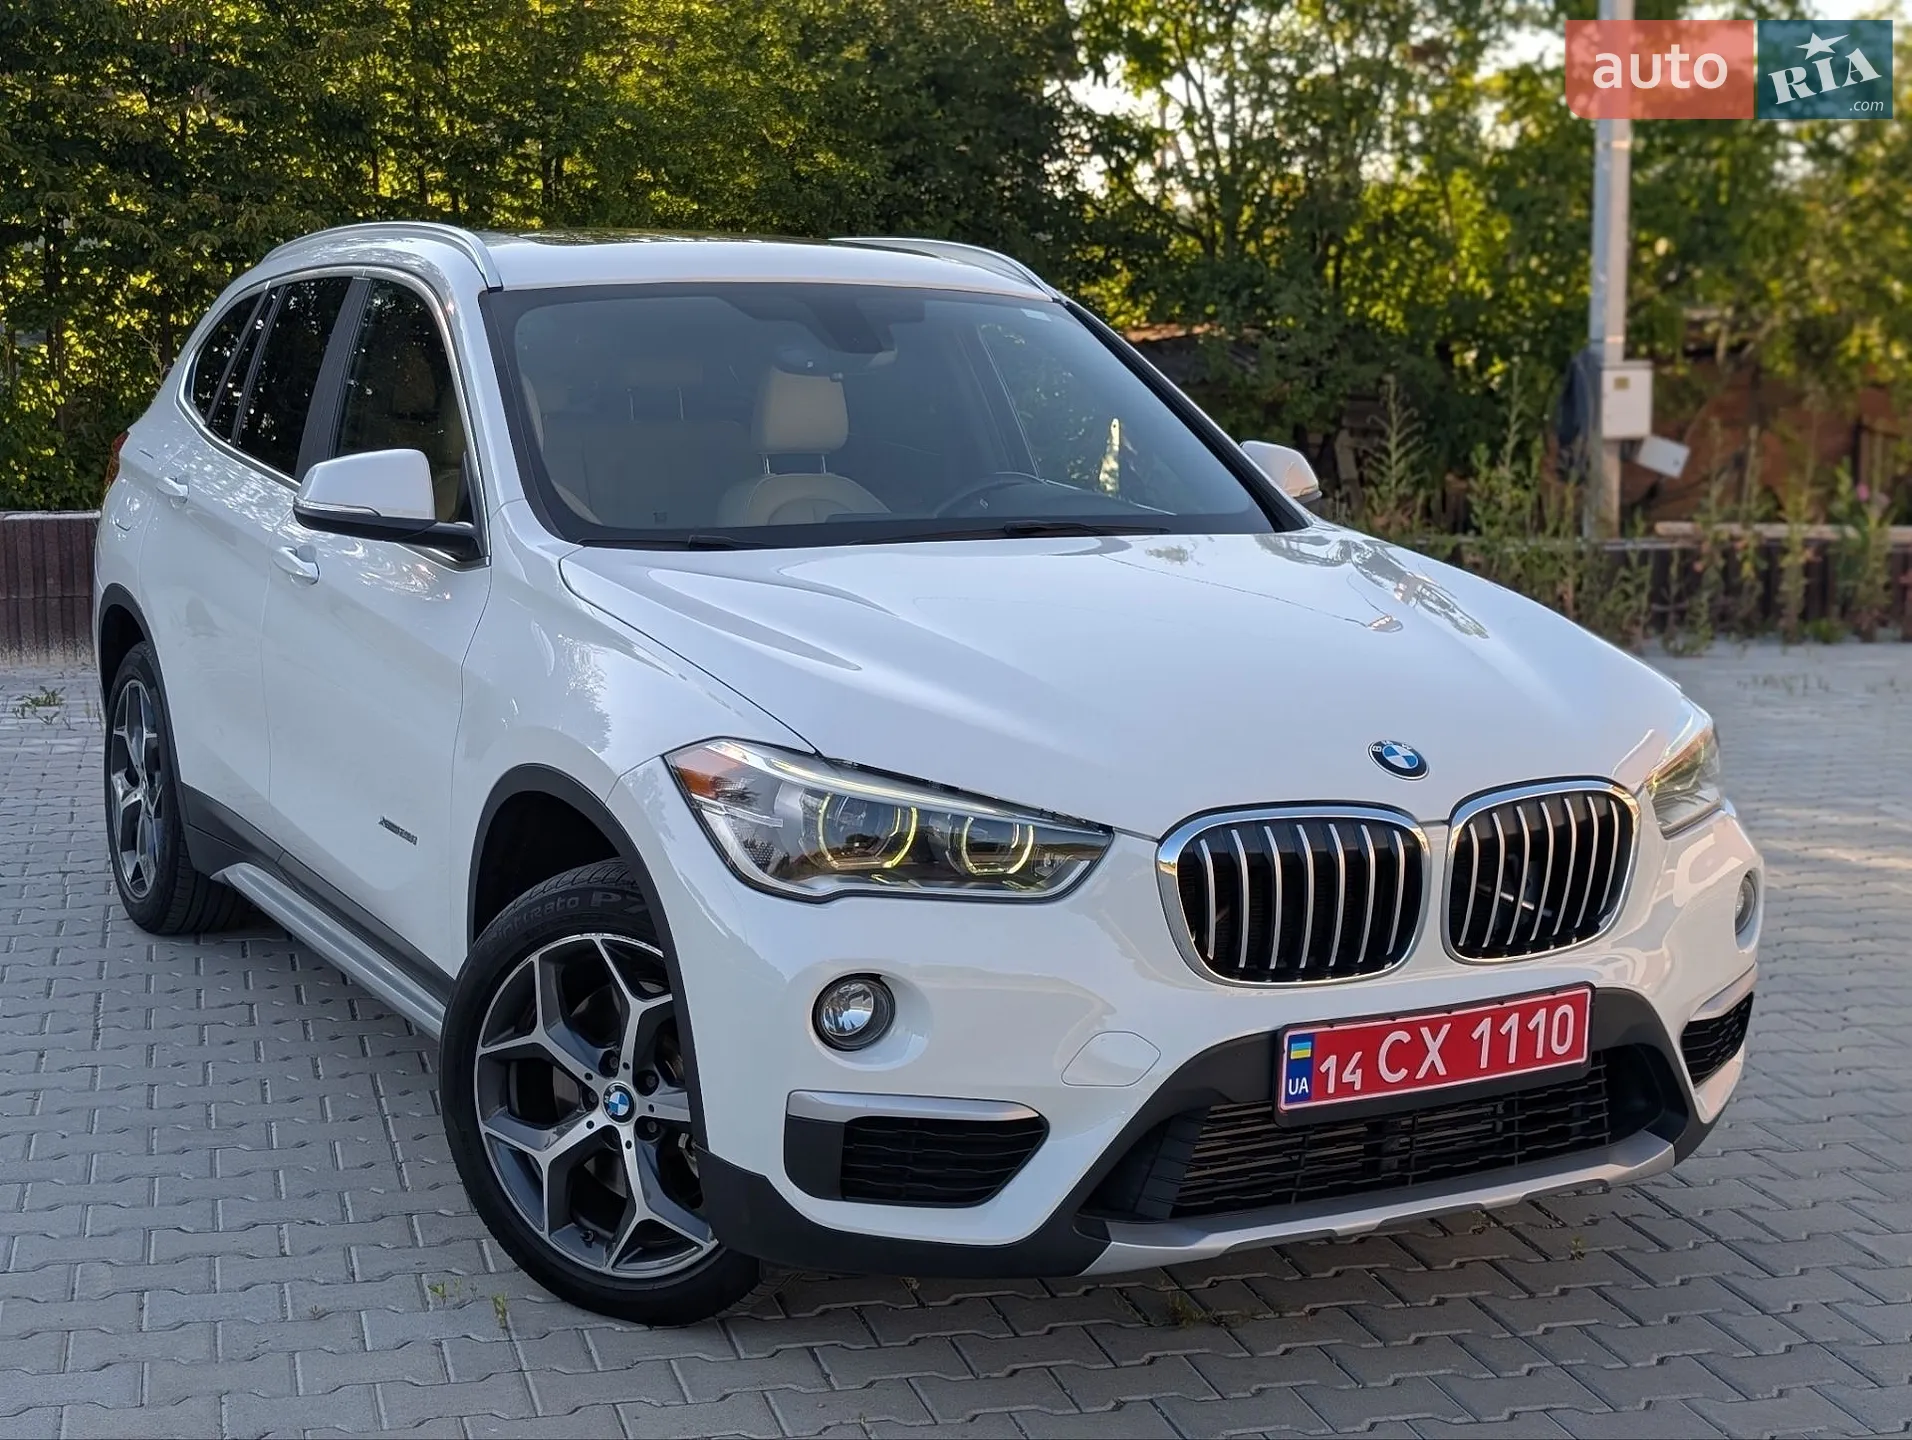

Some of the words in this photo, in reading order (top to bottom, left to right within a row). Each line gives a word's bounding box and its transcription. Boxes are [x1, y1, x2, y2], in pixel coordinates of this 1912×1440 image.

[1319, 1051, 1363, 1094] 14
[1378, 1023, 1452, 1084] CX
[1471, 1004, 1575, 1070] 1110
[1288, 1076, 1310, 1097] UA
